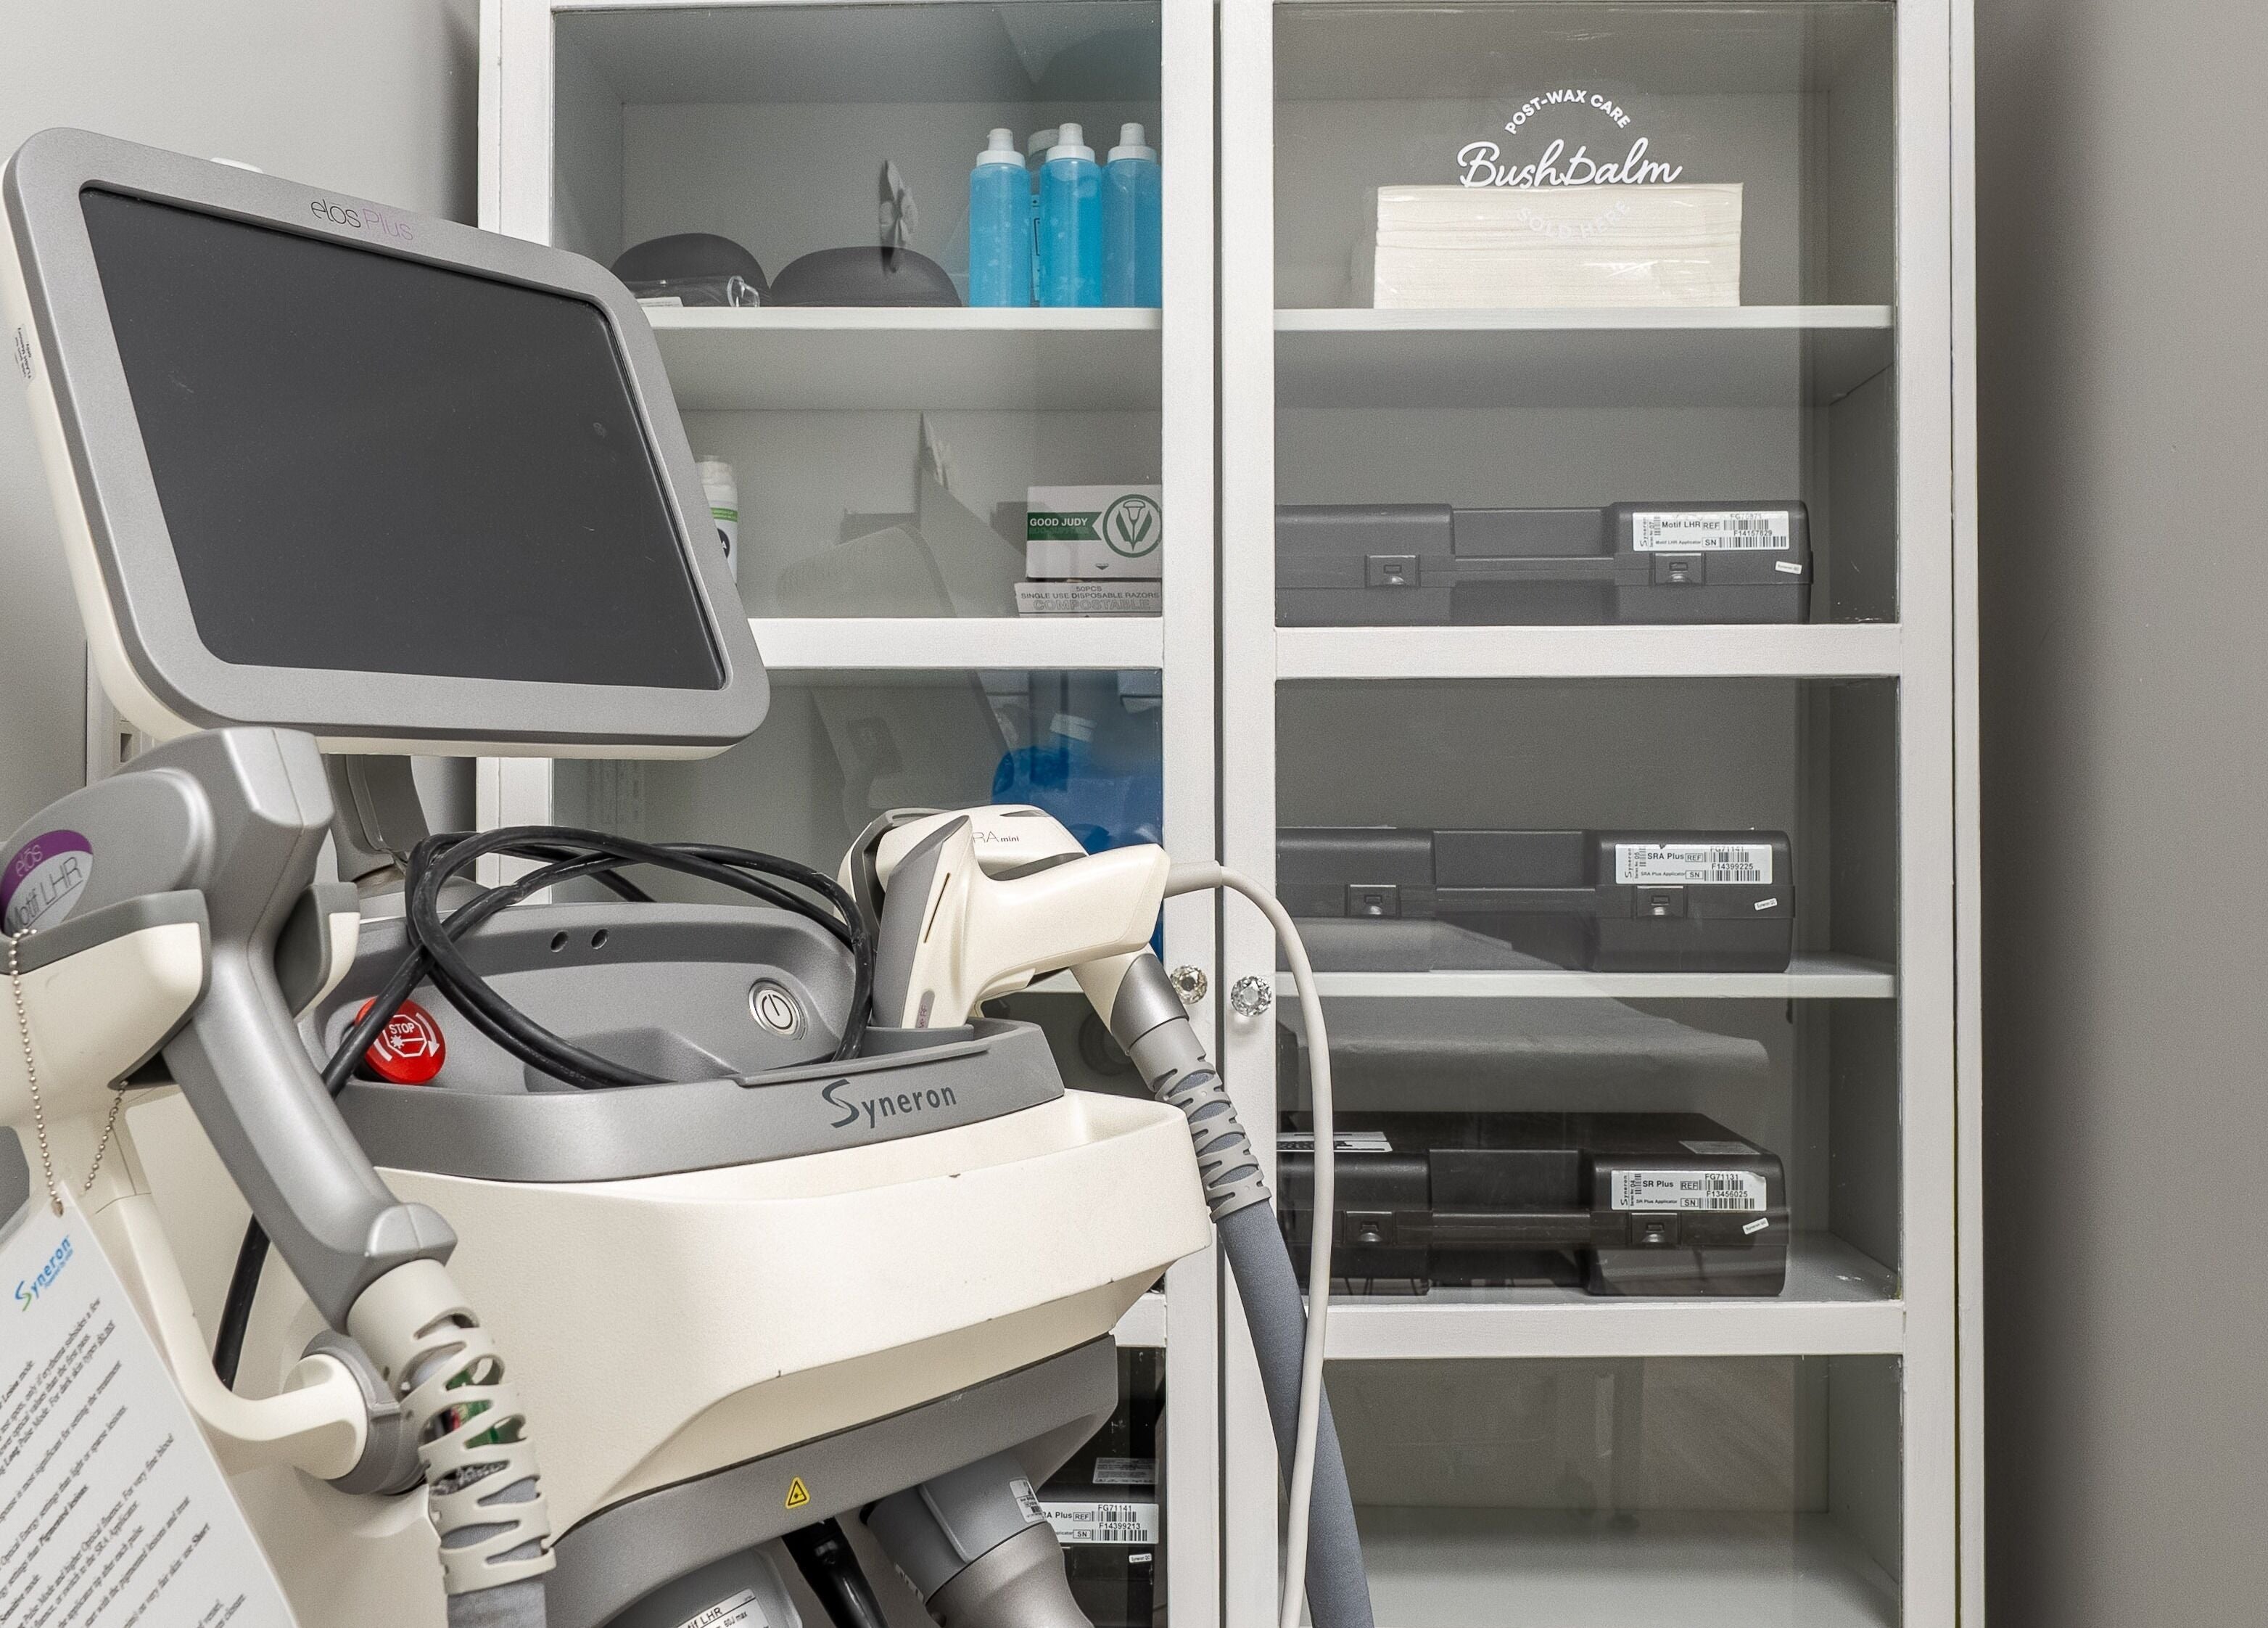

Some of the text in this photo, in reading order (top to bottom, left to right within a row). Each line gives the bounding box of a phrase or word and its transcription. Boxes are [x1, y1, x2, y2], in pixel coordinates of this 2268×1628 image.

[1505, 89, 1631, 135] POST-WAX CARE
[363, 208, 413, 241] Plus
[1029, 517, 1088, 527] GOOD JUDY
[1033, 599, 1150, 611] COMPOSTABLE
[40, 857, 83, 905] LHR
[388, 1022, 415, 1035] STOP
[822, 1078, 957, 1129] Syneron
[15, 1234, 71, 1312] Syneron
[700, 1607, 722, 1625] LHR
[735, 1611, 748, 1622] max
